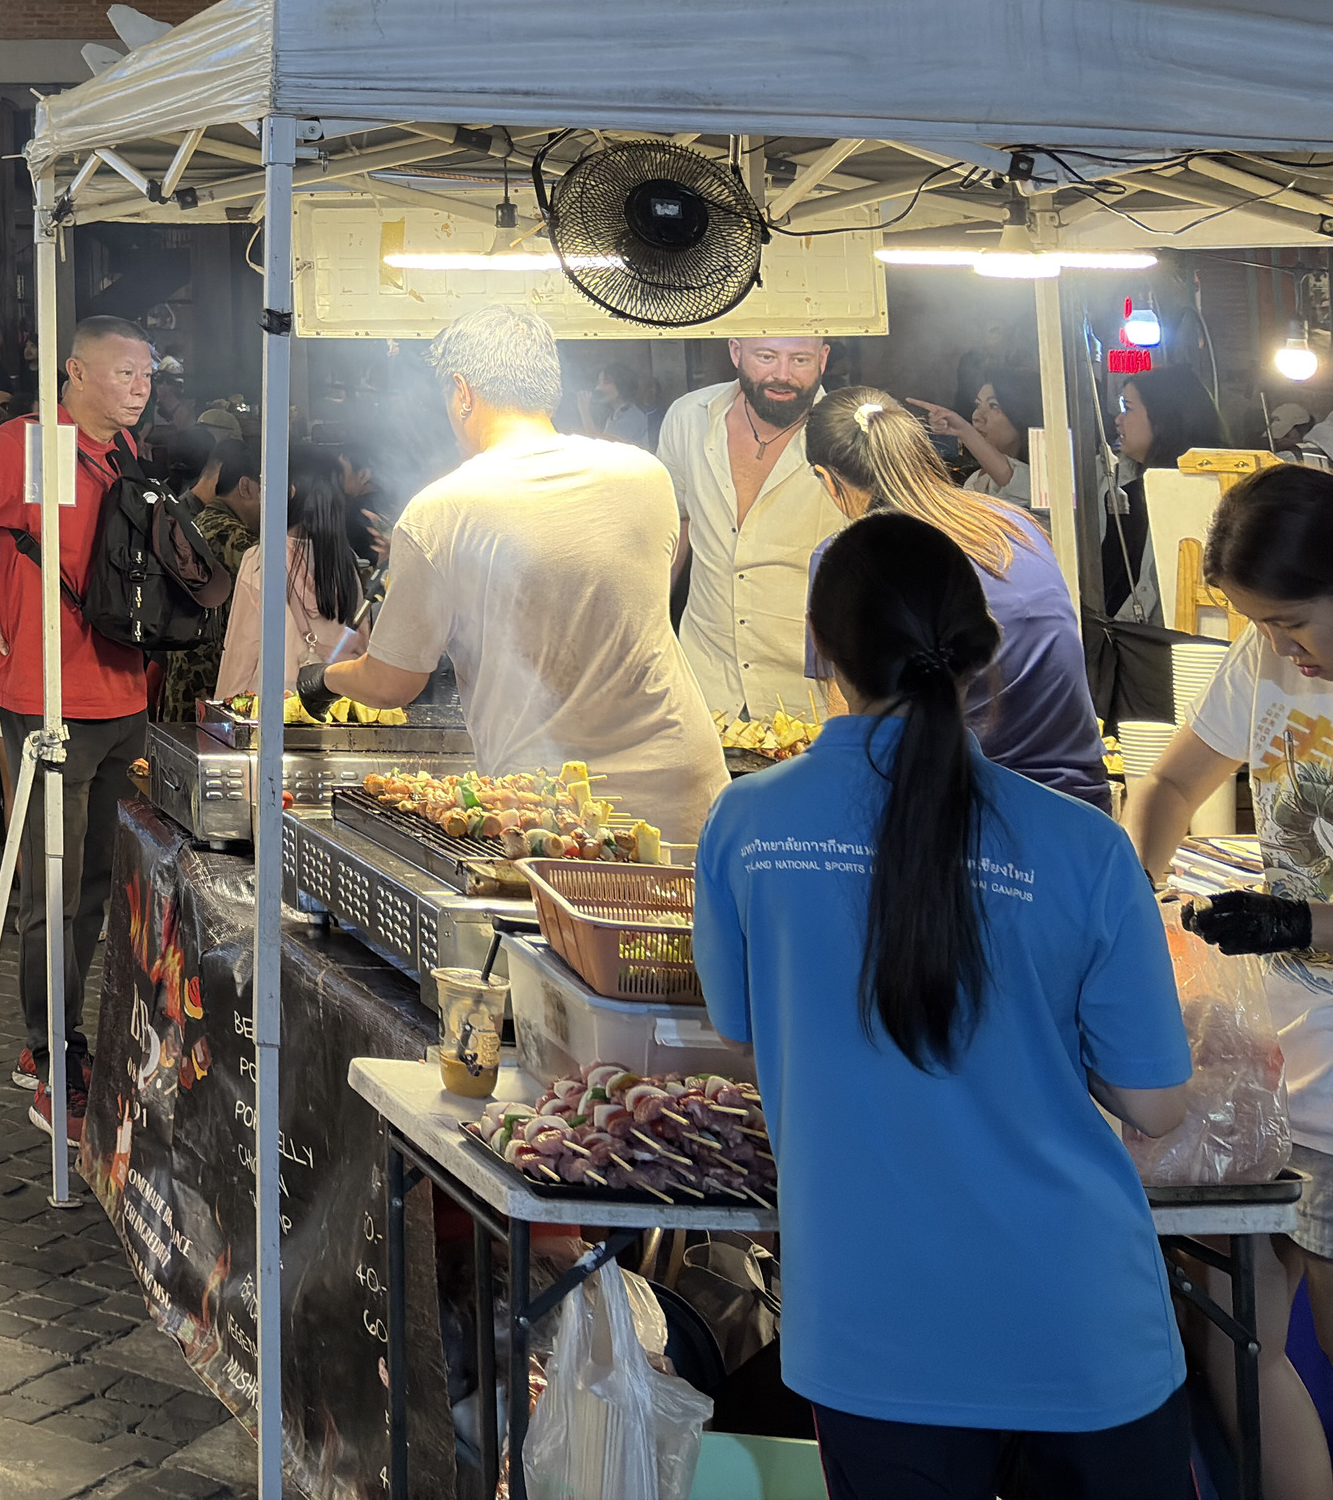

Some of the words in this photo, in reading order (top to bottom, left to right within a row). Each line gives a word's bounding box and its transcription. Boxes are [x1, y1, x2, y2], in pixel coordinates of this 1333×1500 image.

[740, 836, 878, 858] มหาวิทยาลัยการกีฬาแห
[775, 859, 821, 871] NATIONAL
[824, 861, 865, 874] SPORTS
[992, 883, 1033, 902] CAMPUS
[233, 1010, 254, 1040] BE
[239, 1057, 257, 1084] PO
[235, 1100, 257, 1131] POR
[127, 1168, 167, 1218] OMEMADE
[143, 1266, 154, 1292] NO
[151, 1278, 172, 1311] MSG
[222, 1355, 259, 1411] MUSHR
